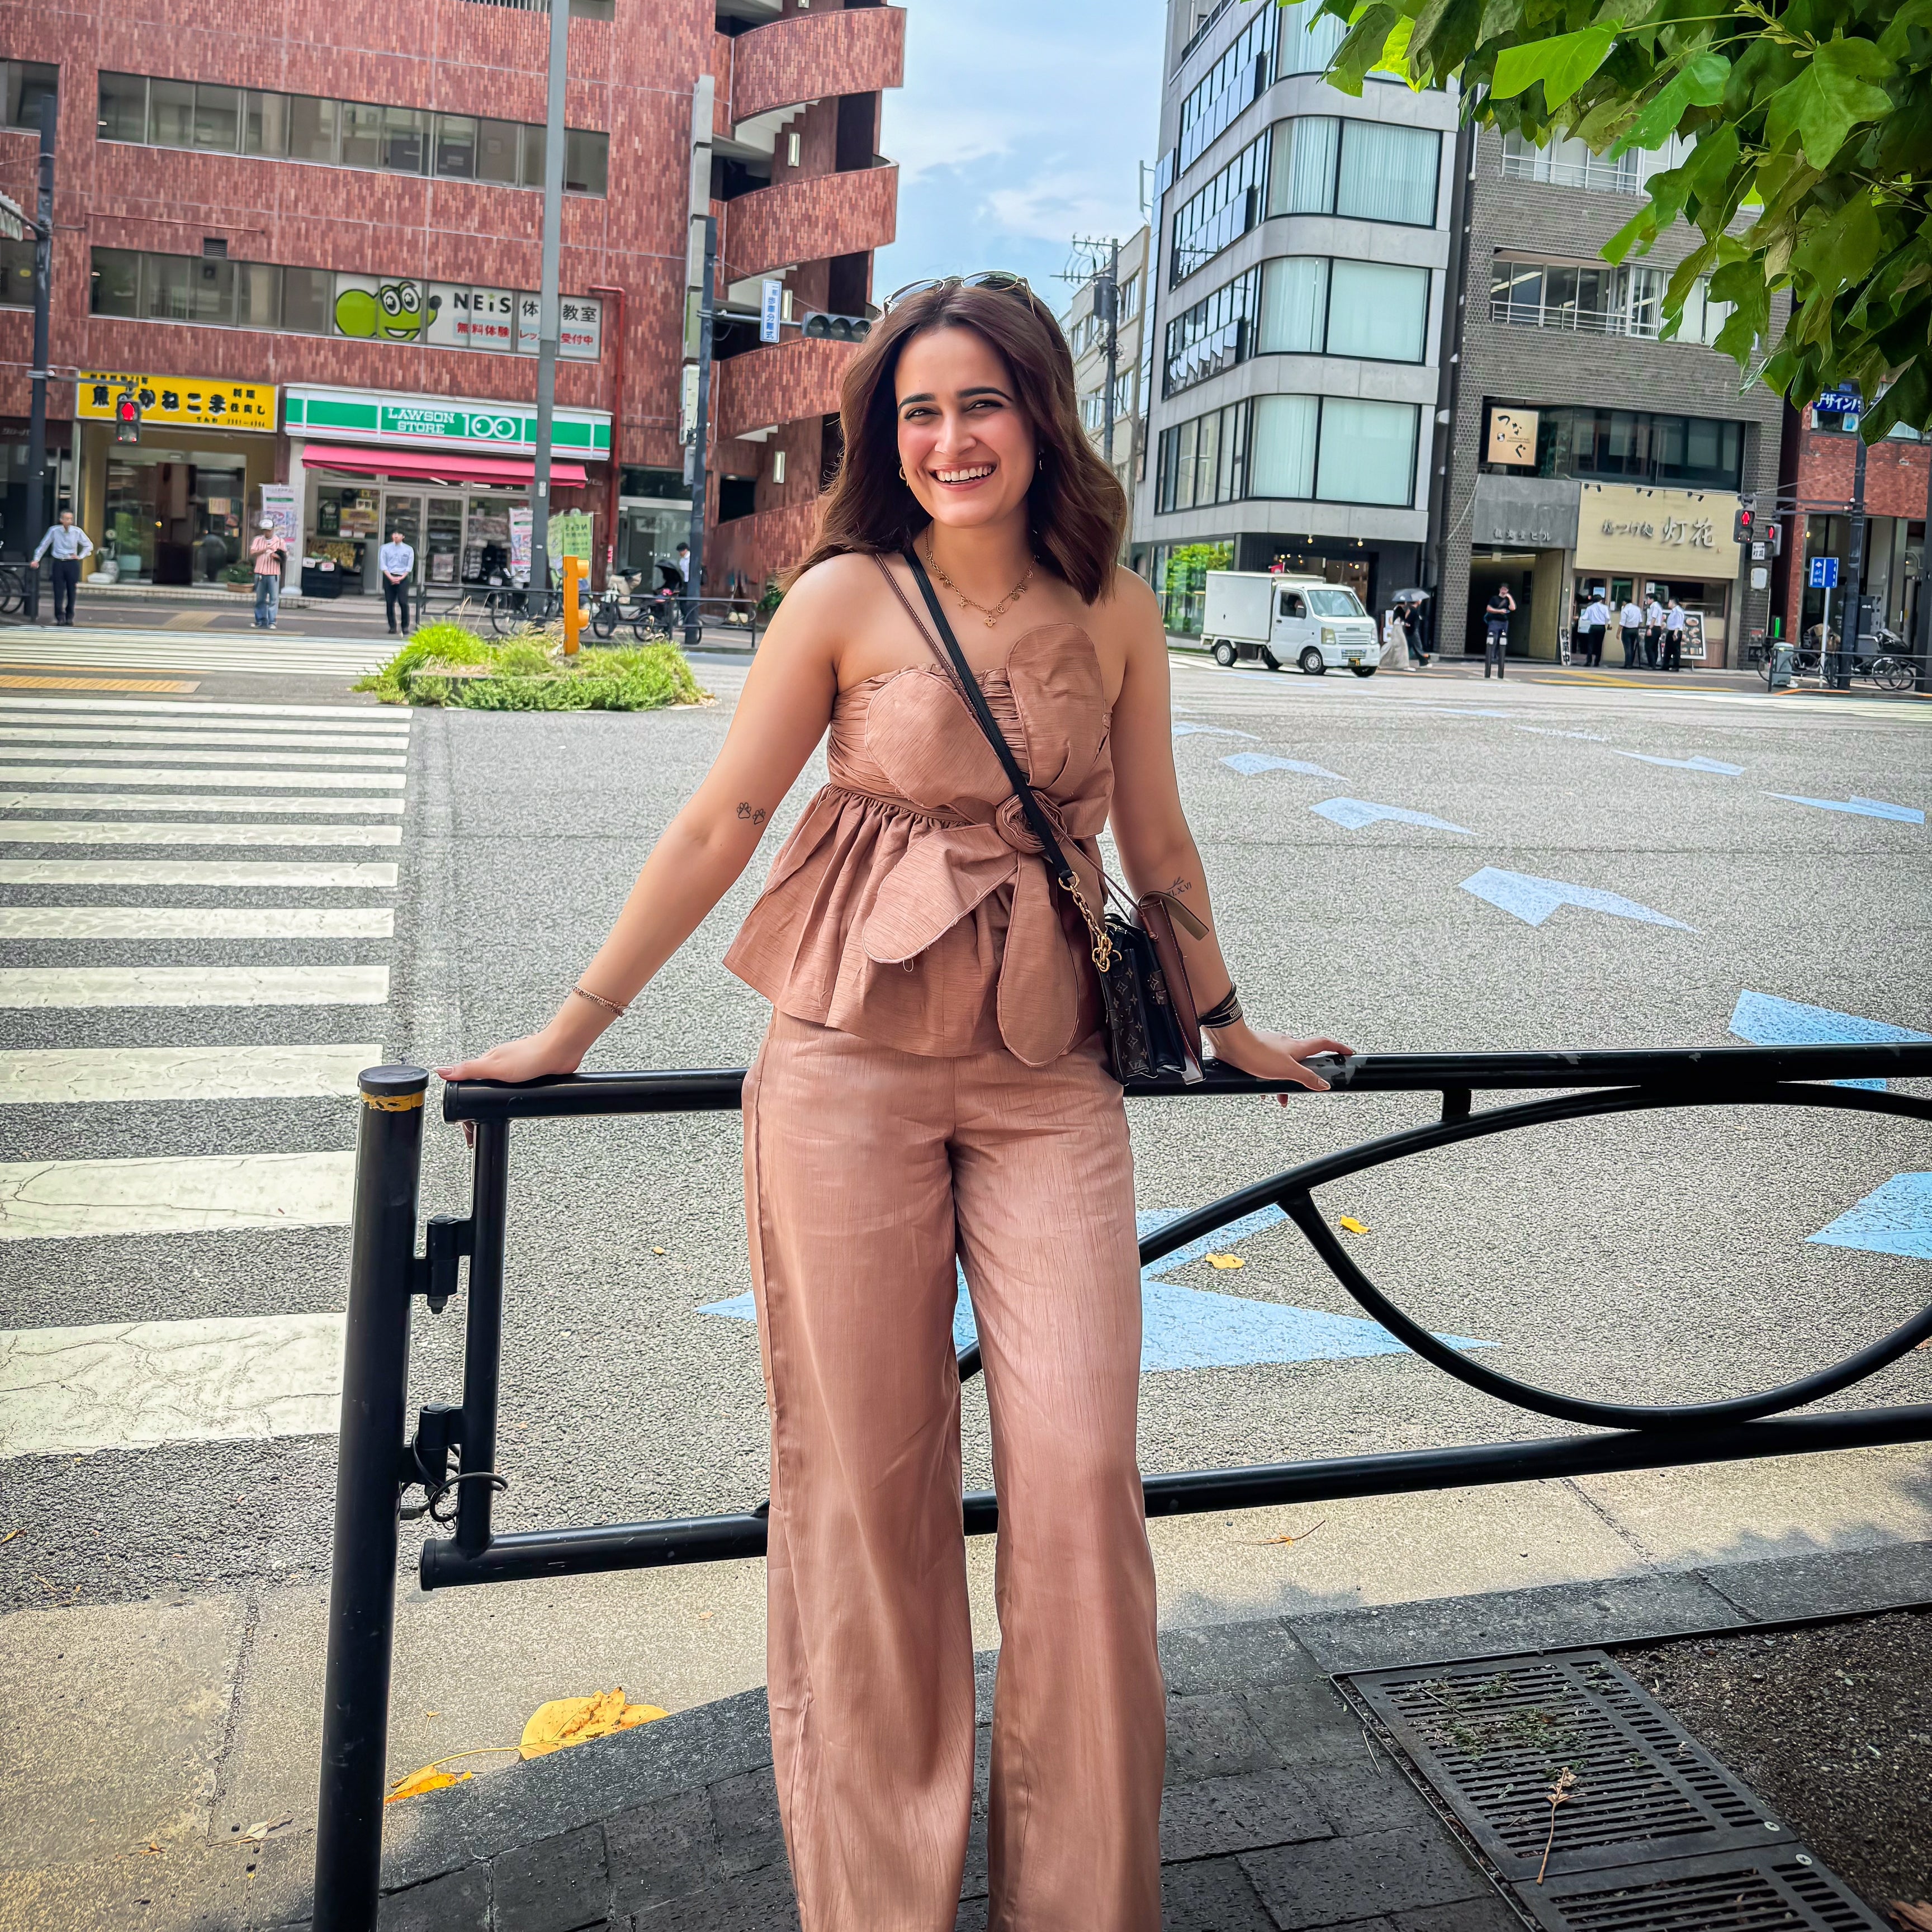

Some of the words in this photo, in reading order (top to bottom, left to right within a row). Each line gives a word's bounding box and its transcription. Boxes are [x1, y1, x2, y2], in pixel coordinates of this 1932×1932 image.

[522, 300, 597, 323] 体教室
[388, 408, 455, 424] LAWSON
[397, 420, 445, 434] STORE
[462, 414, 516, 439] 100
[1662, 516, 1715, 547] 灯花
